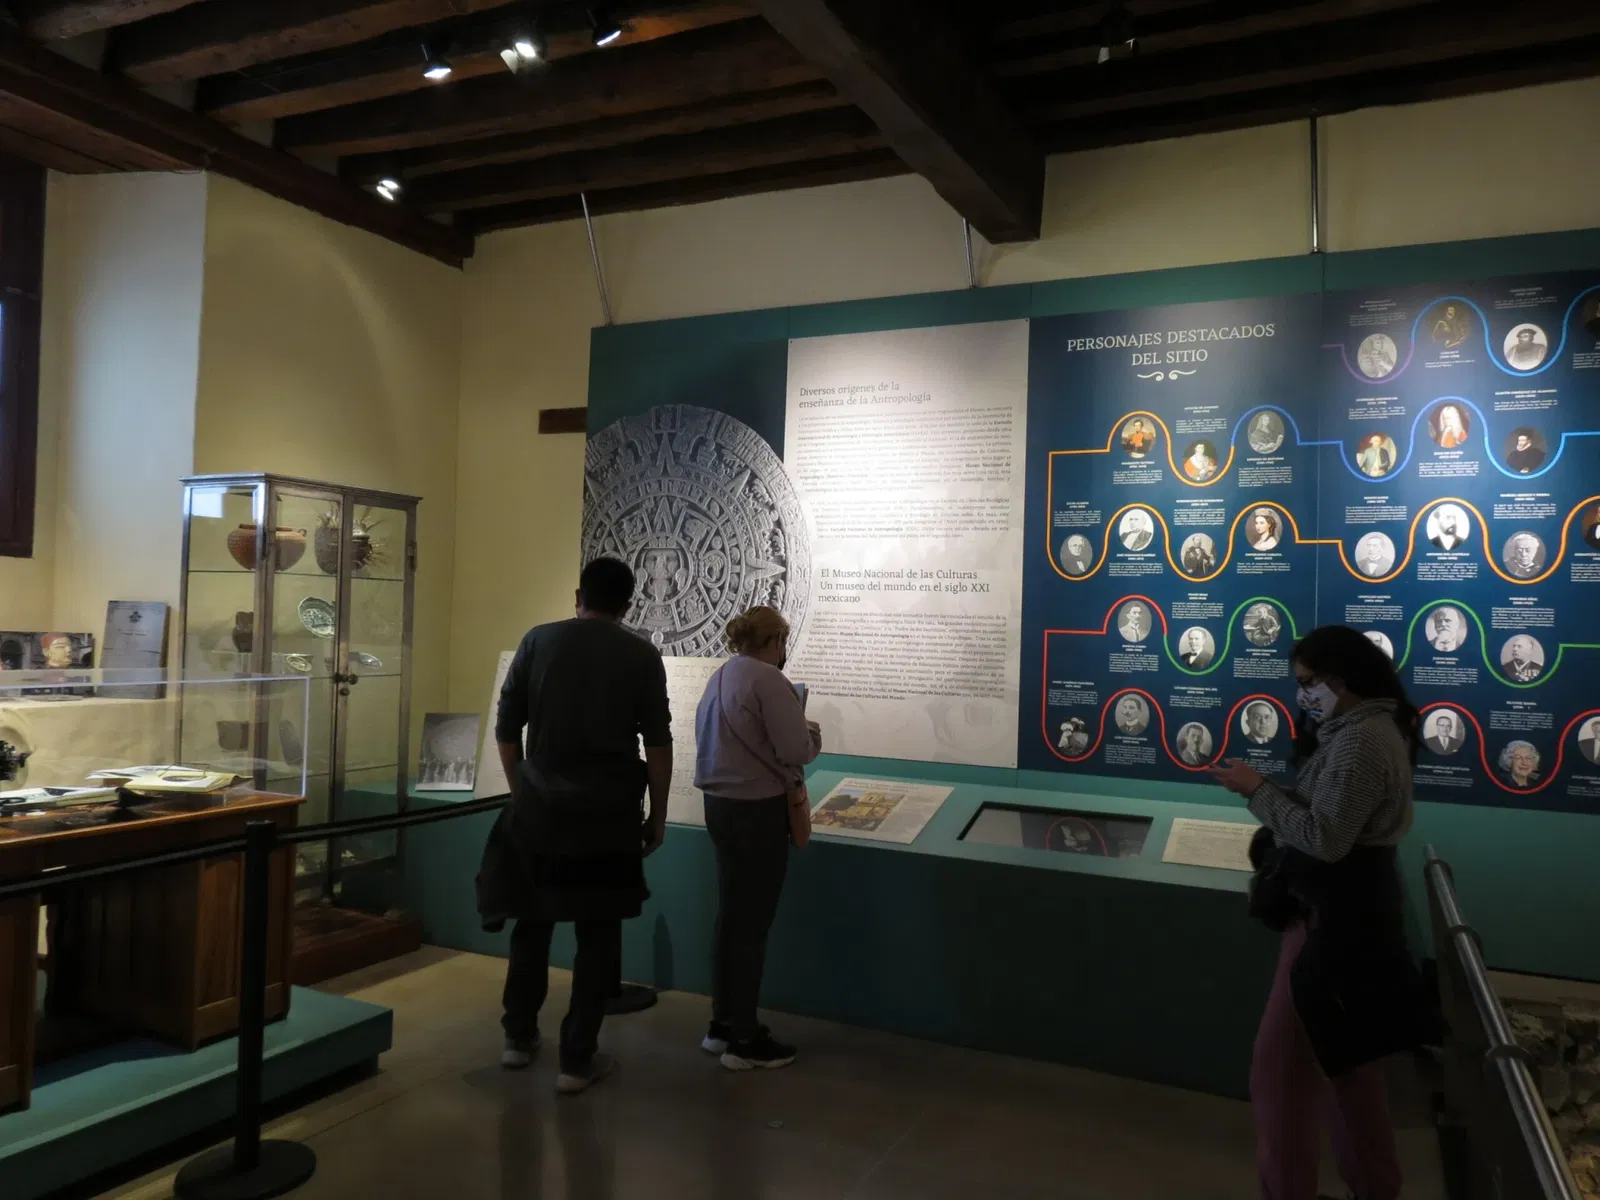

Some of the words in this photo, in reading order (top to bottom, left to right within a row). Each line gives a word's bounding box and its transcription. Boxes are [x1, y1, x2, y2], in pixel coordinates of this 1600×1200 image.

[1066, 332, 1162, 352] PERSONAJES
[1167, 323, 1276, 344] DESTACADOS
[1131, 351, 1162, 366] DEL
[1165, 348, 1209, 364] SITIO
[799, 386, 835, 397] Diversos
[837, 383, 876, 395] orígenes
[877, 381, 889, 391] de
[891, 380, 900, 391] la
[798, 397, 844, 409] enseñanza
[846, 395, 857, 405] de
[859, 395, 868, 405] la
[870, 390, 932, 405] Antropología
[820, 567, 830, 578] El
[832, 567, 862, 578] Museo
[863, 567, 904, 579] Nacional
[906, 568, 918, 579] de
[920, 568, 934, 579] las
[935, 568, 981, 580] Culturas.
[819, 580, 834, 591] Un
[835, 581, 866, 591] museo
[867, 580, 881, 591] del
[883, 581, 917, 592] mundo
[918, 583, 931, 592] en
[933, 581, 942, 592] el
[944, 581, 968, 595] siglo
[970, 582, 990, 593] XXI
[817, 594, 861, 604] mexicano
